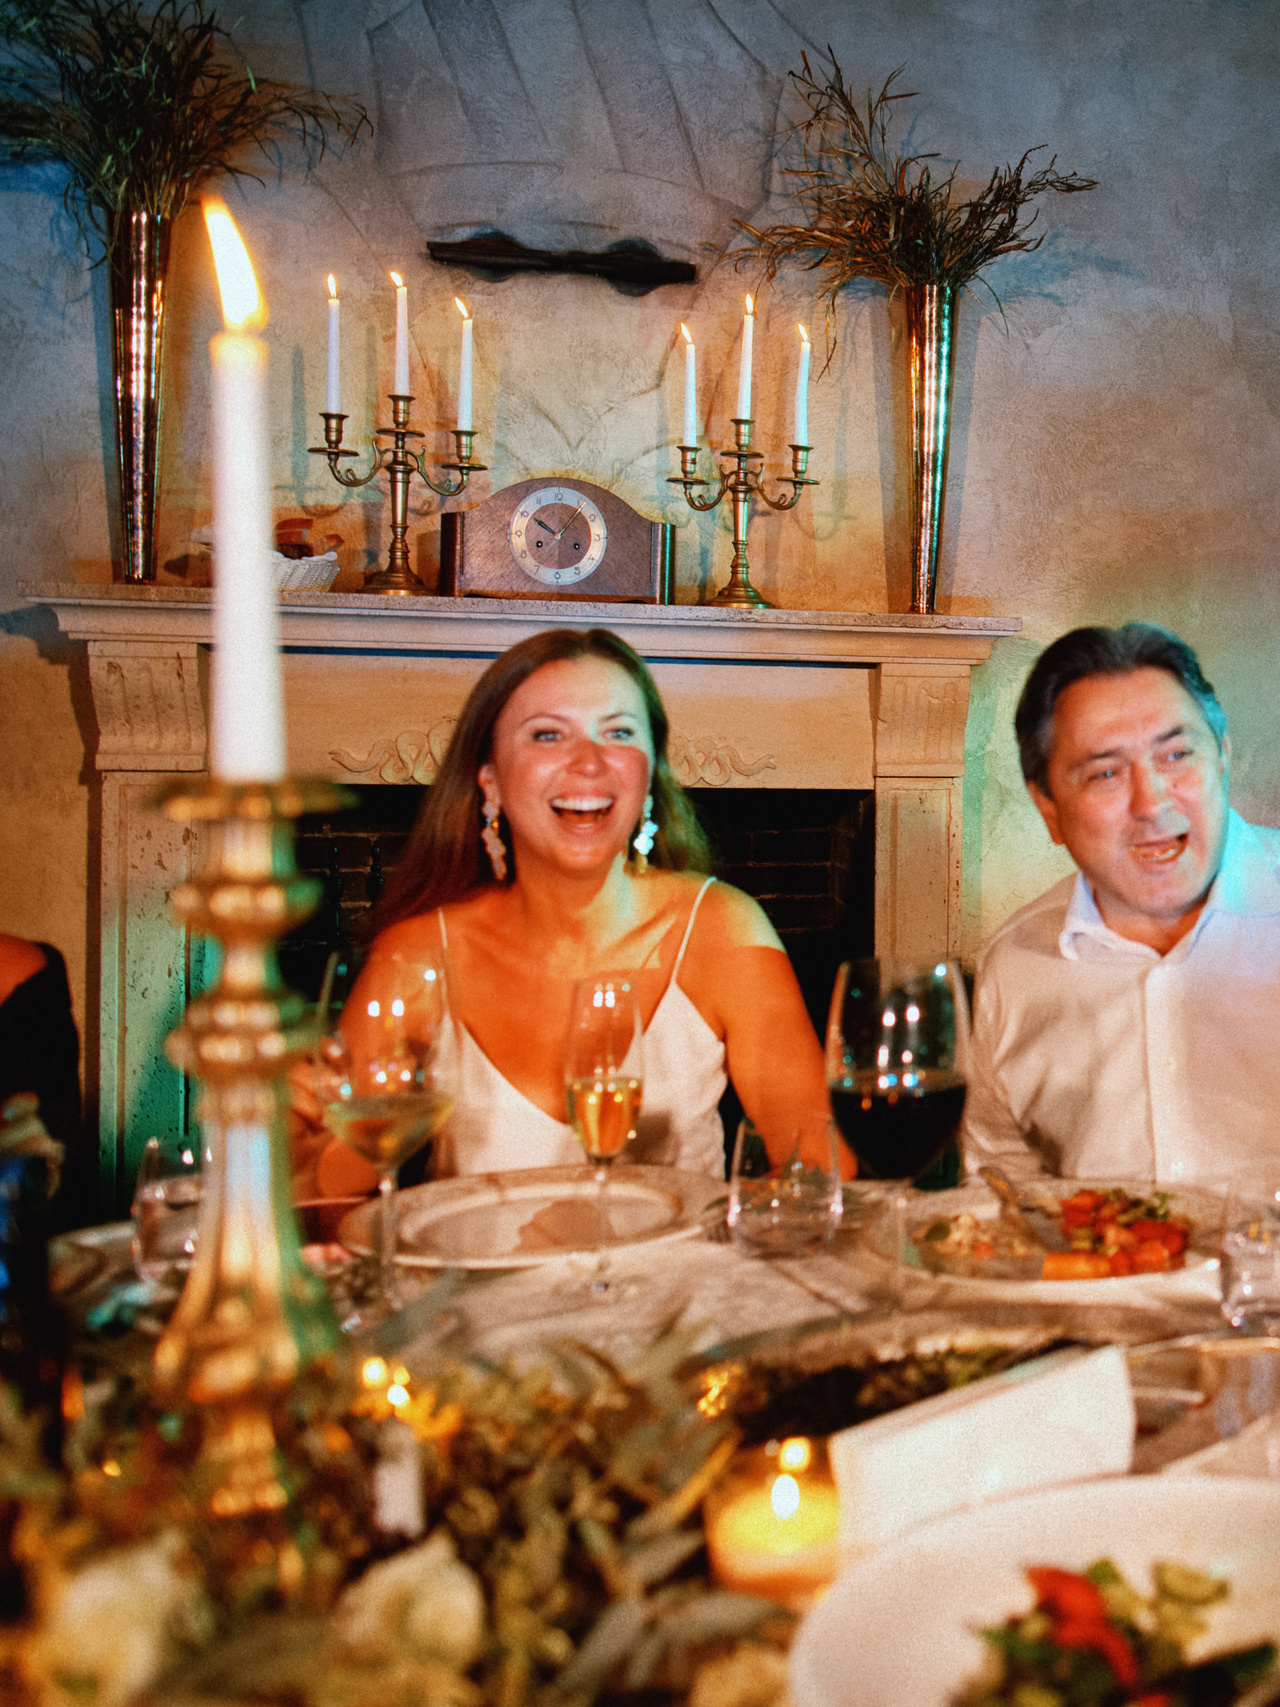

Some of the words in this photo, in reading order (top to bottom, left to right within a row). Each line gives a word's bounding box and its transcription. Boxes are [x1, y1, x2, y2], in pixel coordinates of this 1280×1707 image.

[536, 496, 542, 505] 11
[554, 492, 564, 501] 12
[520, 510, 530, 518] 10
[588, 513, 597, 522] 2
[515, 530, 523, 538] 9
[594, 533, 601, 542] 3
[520, 549, 528, 559] 8
[588, 553, 595, 561] 4
[533, 564, 540, 575] 7
[574, 567, 581, 576] 5
[553, 571, 562, 580] 6
